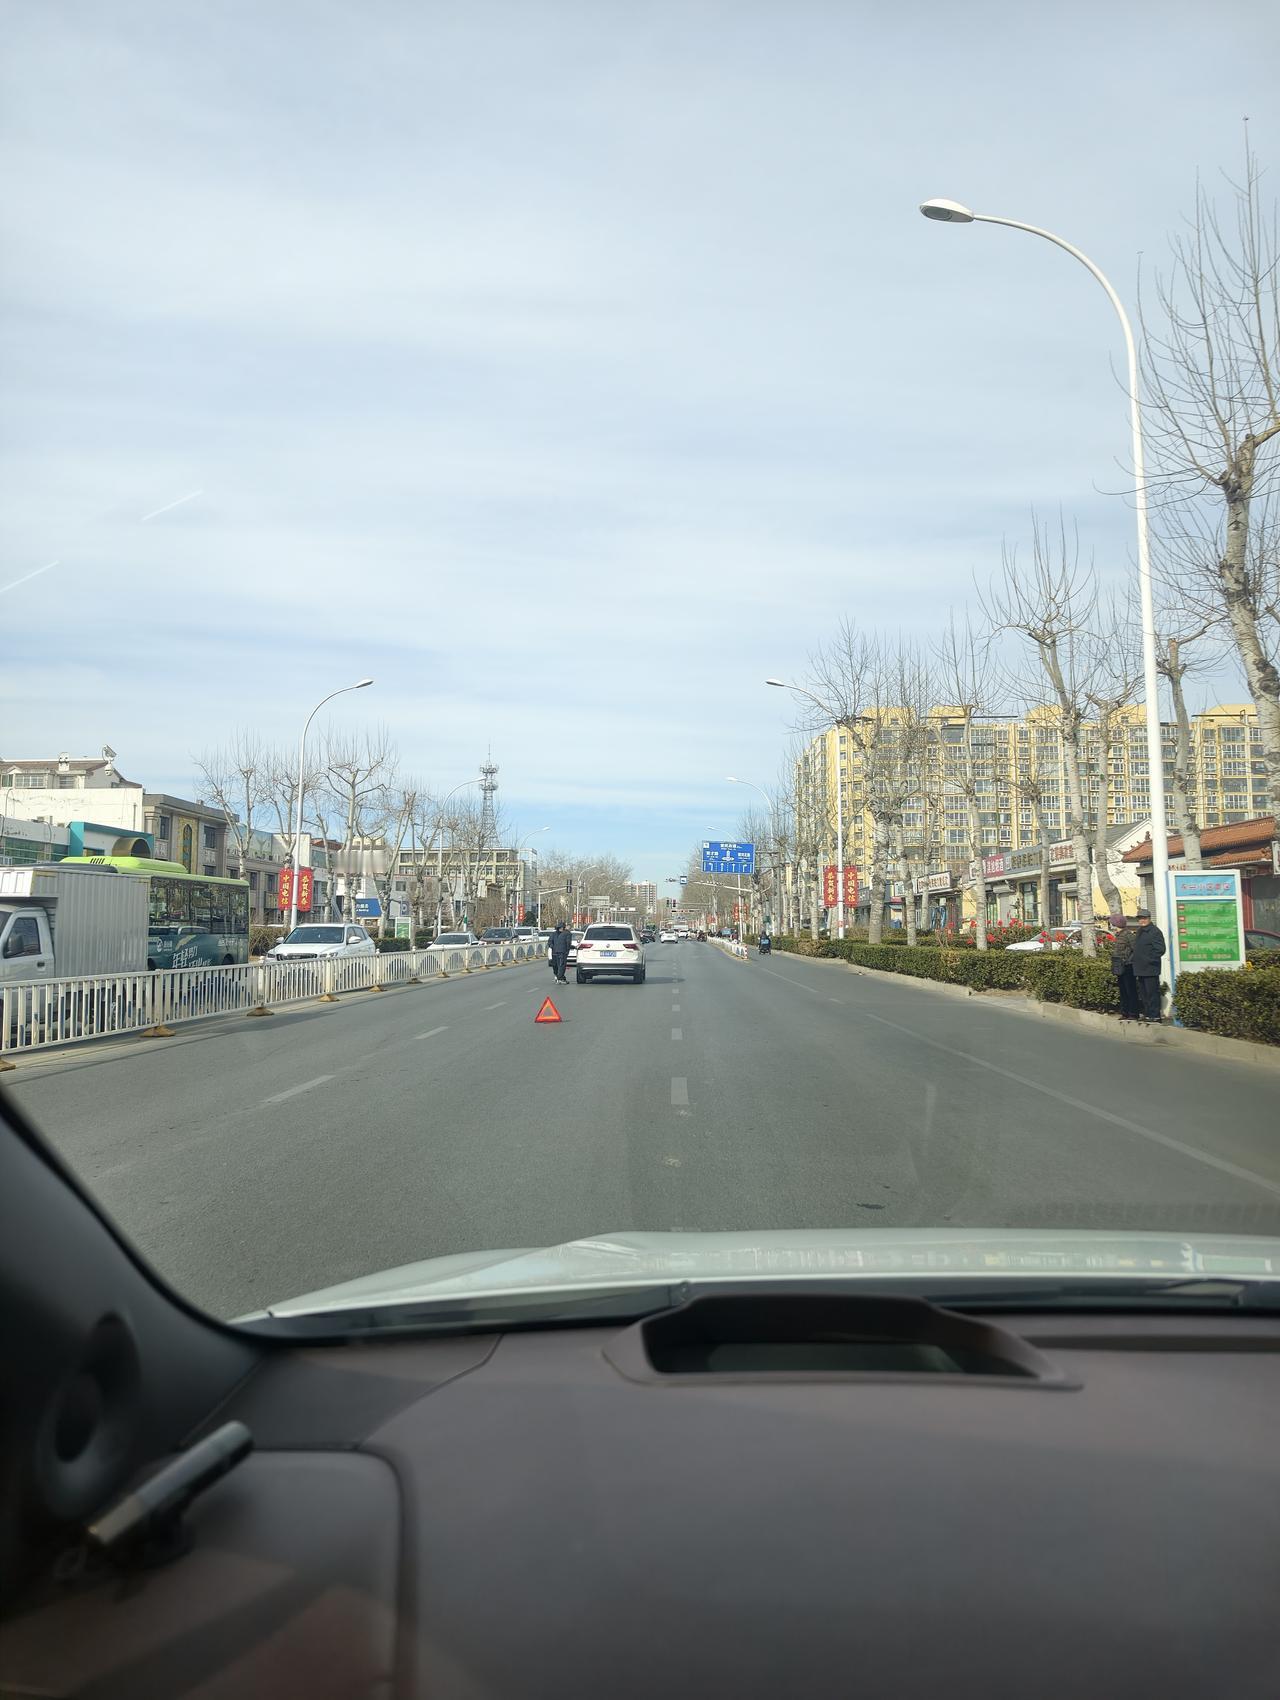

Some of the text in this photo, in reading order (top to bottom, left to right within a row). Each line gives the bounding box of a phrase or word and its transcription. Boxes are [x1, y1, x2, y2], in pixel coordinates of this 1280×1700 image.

[281, 874, 290, 905] 中国电信
[301, 875, 310, 906] 恭贺新春
[847, 872, 856, 902] 中国电信
